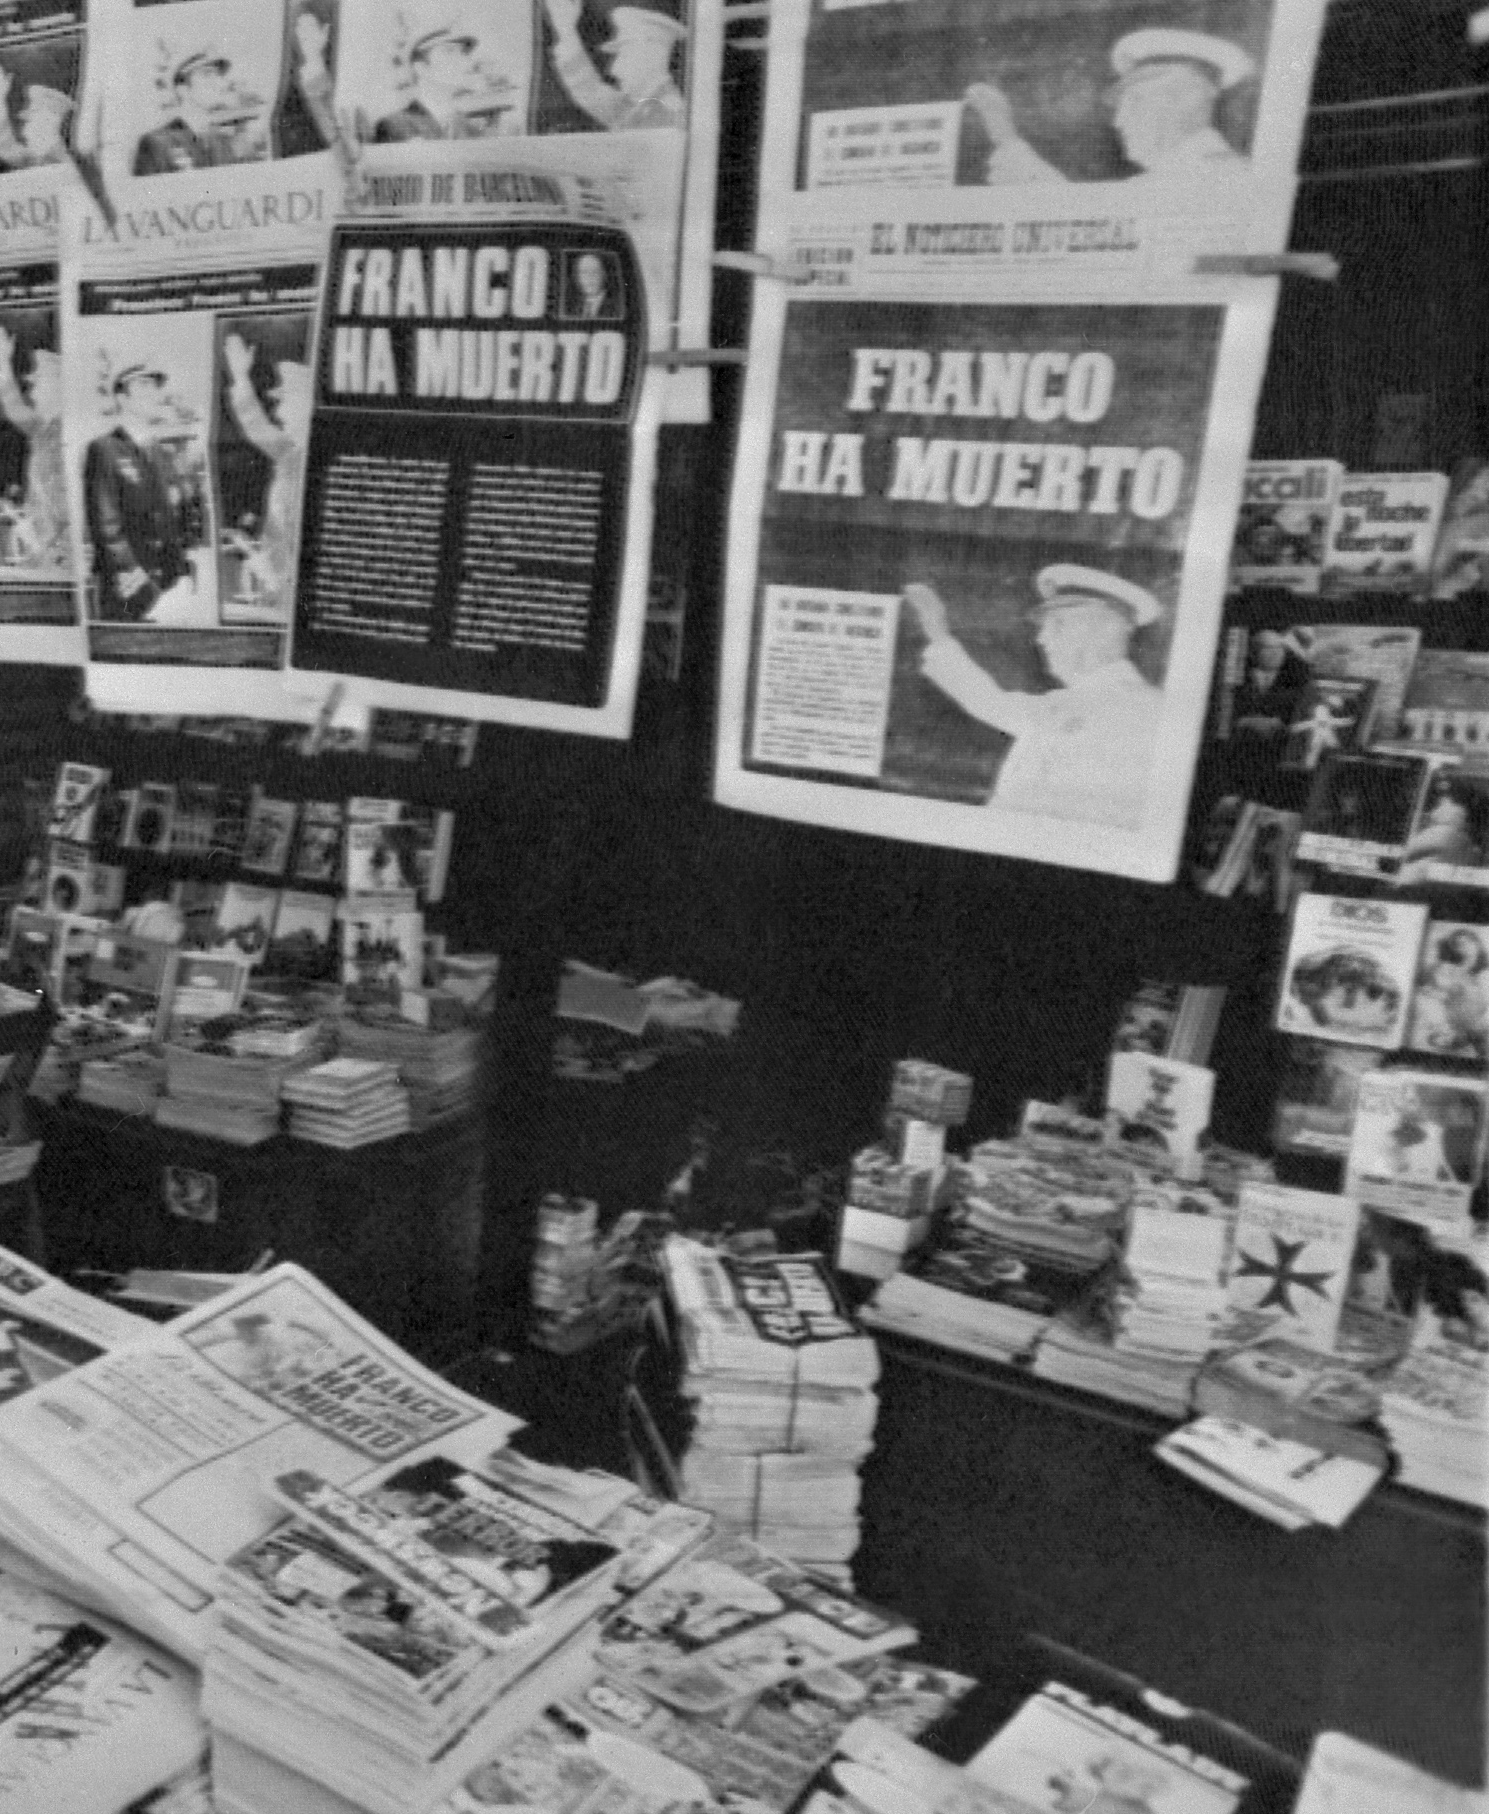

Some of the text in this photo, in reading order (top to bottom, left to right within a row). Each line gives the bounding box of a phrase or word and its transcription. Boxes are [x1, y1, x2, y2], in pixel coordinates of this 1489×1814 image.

[125, 189, 324, 240] VANGUARDI
[337, 246, 550, 318] FRANCO
[333, 327, 626, 404] HA MUERTO
[846, 346, 1116, 423] FRANCO
[777, 429, 1185, 521] HA MUERTO
[282, 1382, 404, 1452] MUERTO
[311, 1368, 361, 1401] HA
[339, 1352, 461, 1425] FRANCO
